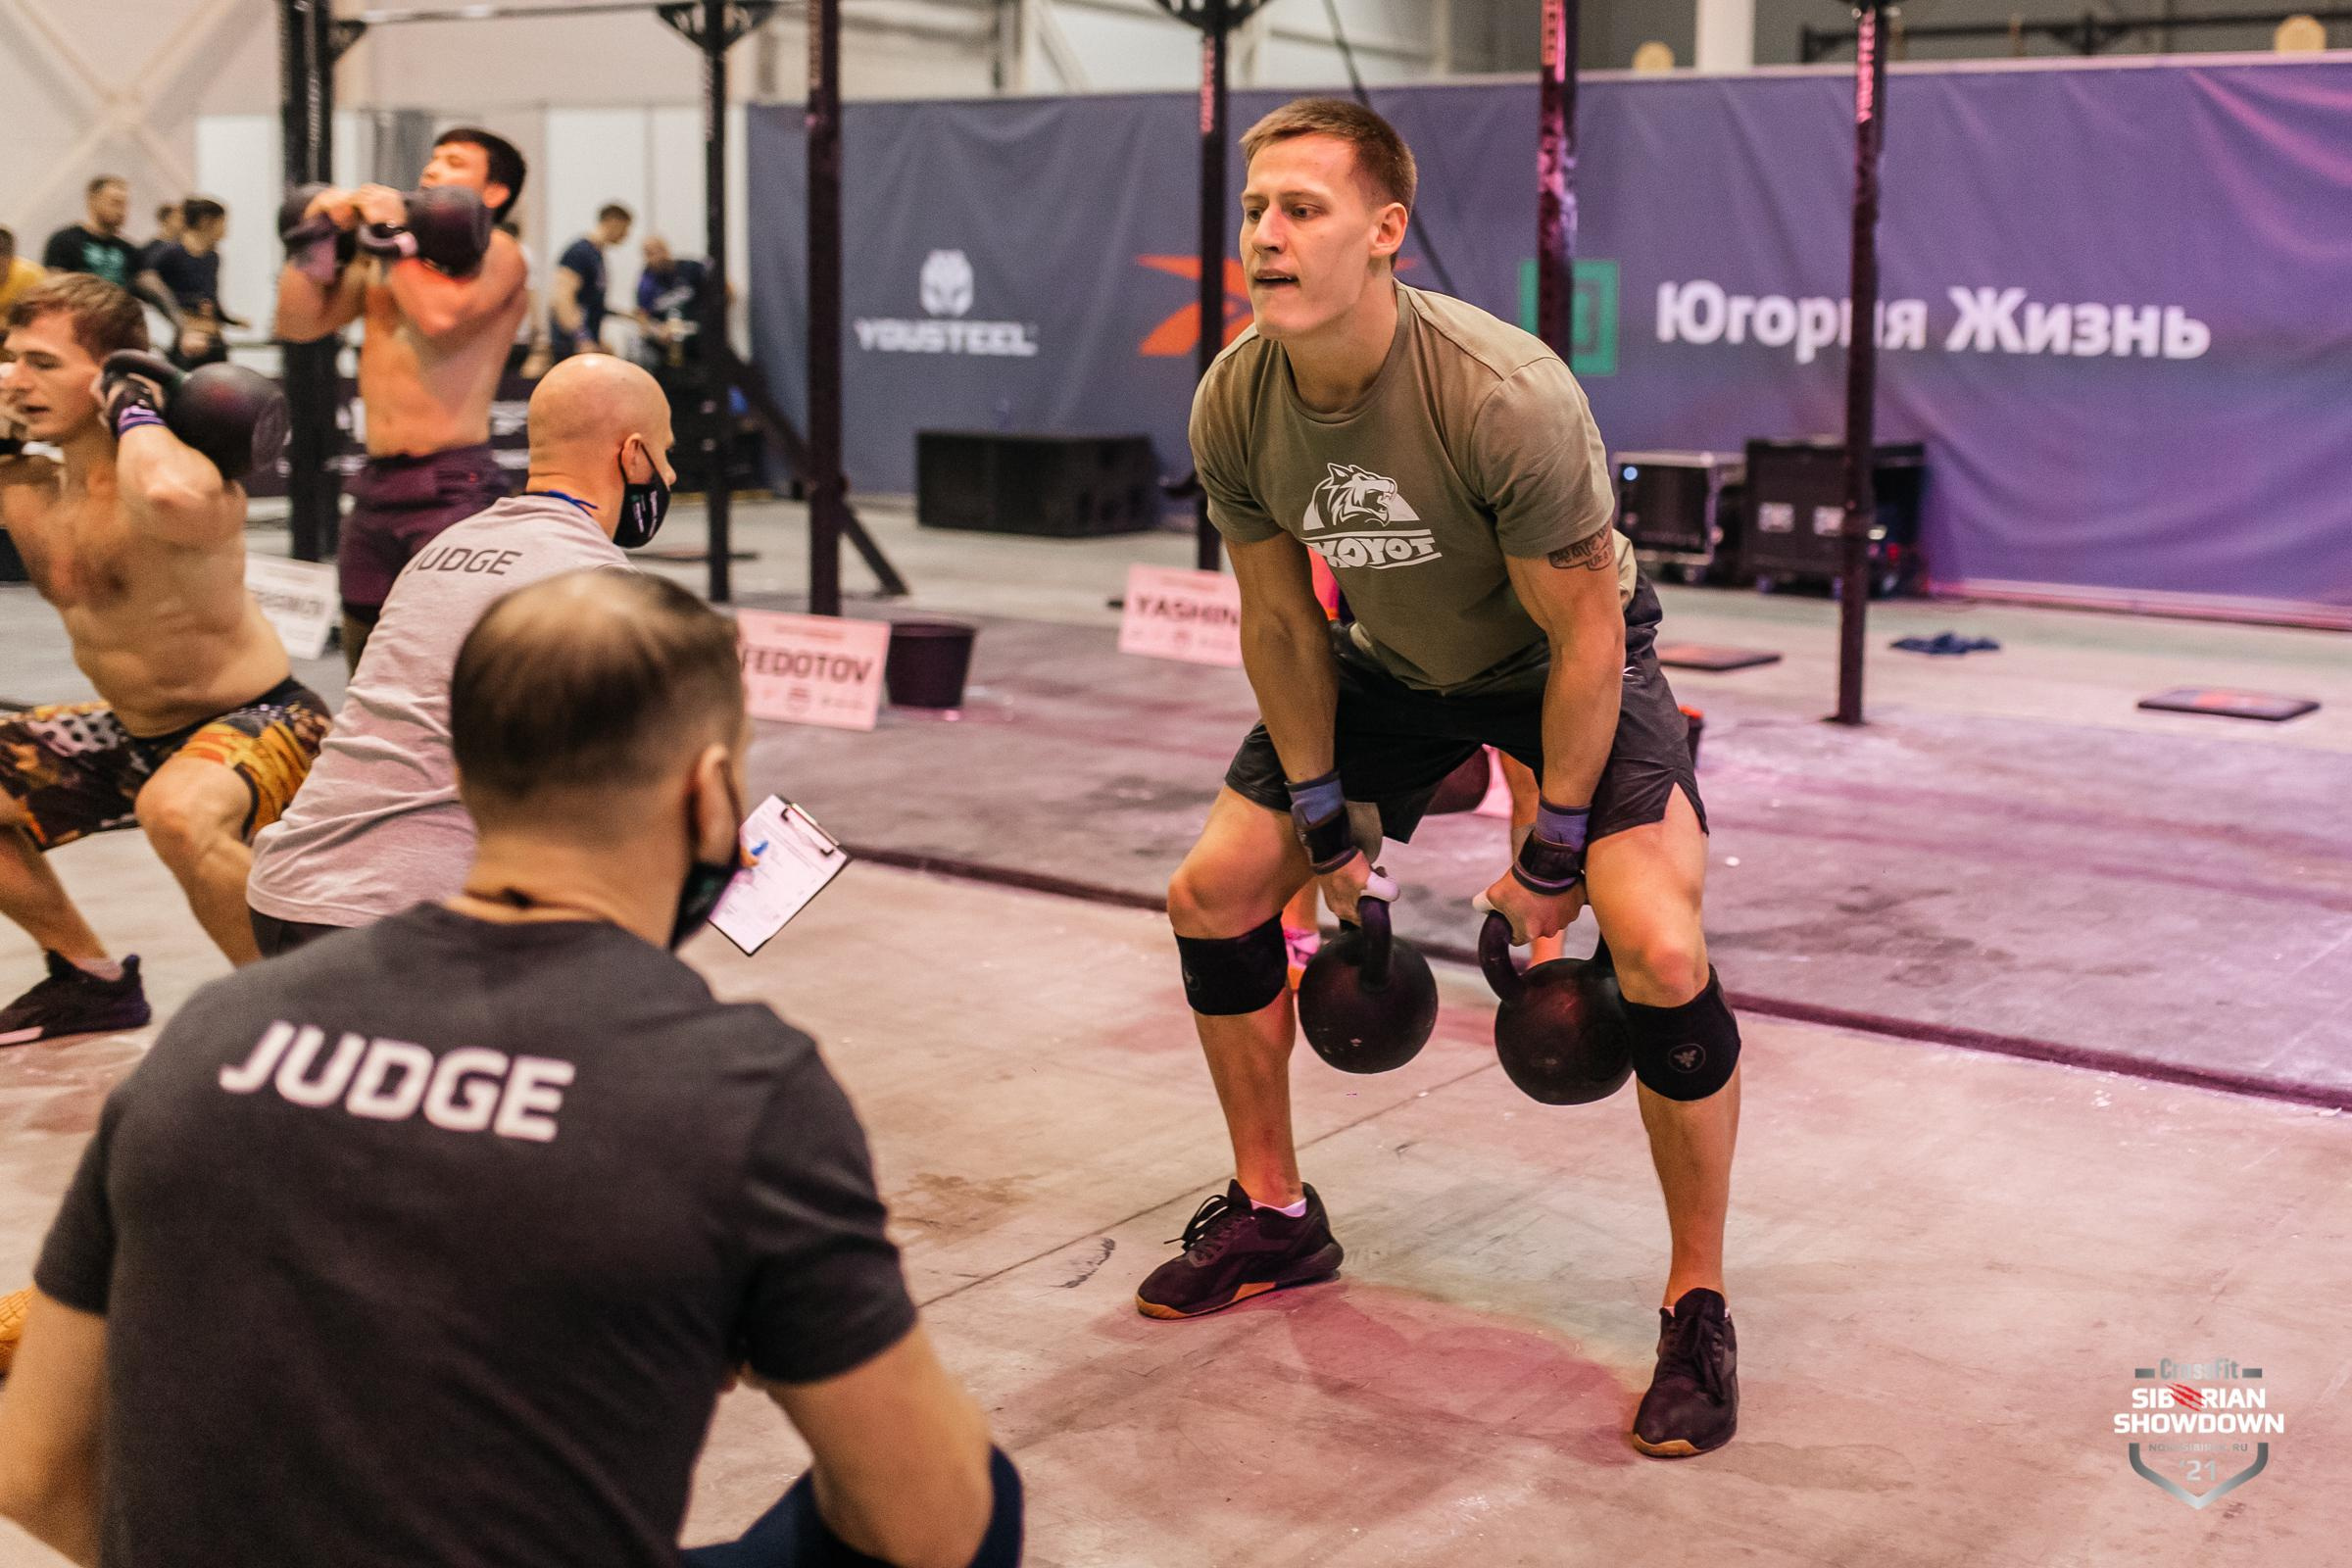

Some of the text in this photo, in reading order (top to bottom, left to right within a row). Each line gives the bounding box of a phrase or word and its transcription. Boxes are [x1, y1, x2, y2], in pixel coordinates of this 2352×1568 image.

[1945, 286, 2211, 359] Жизнь
[404, 547, 522, 575] JUDGE
[219, 1019, 576, 1143] JUDGE
